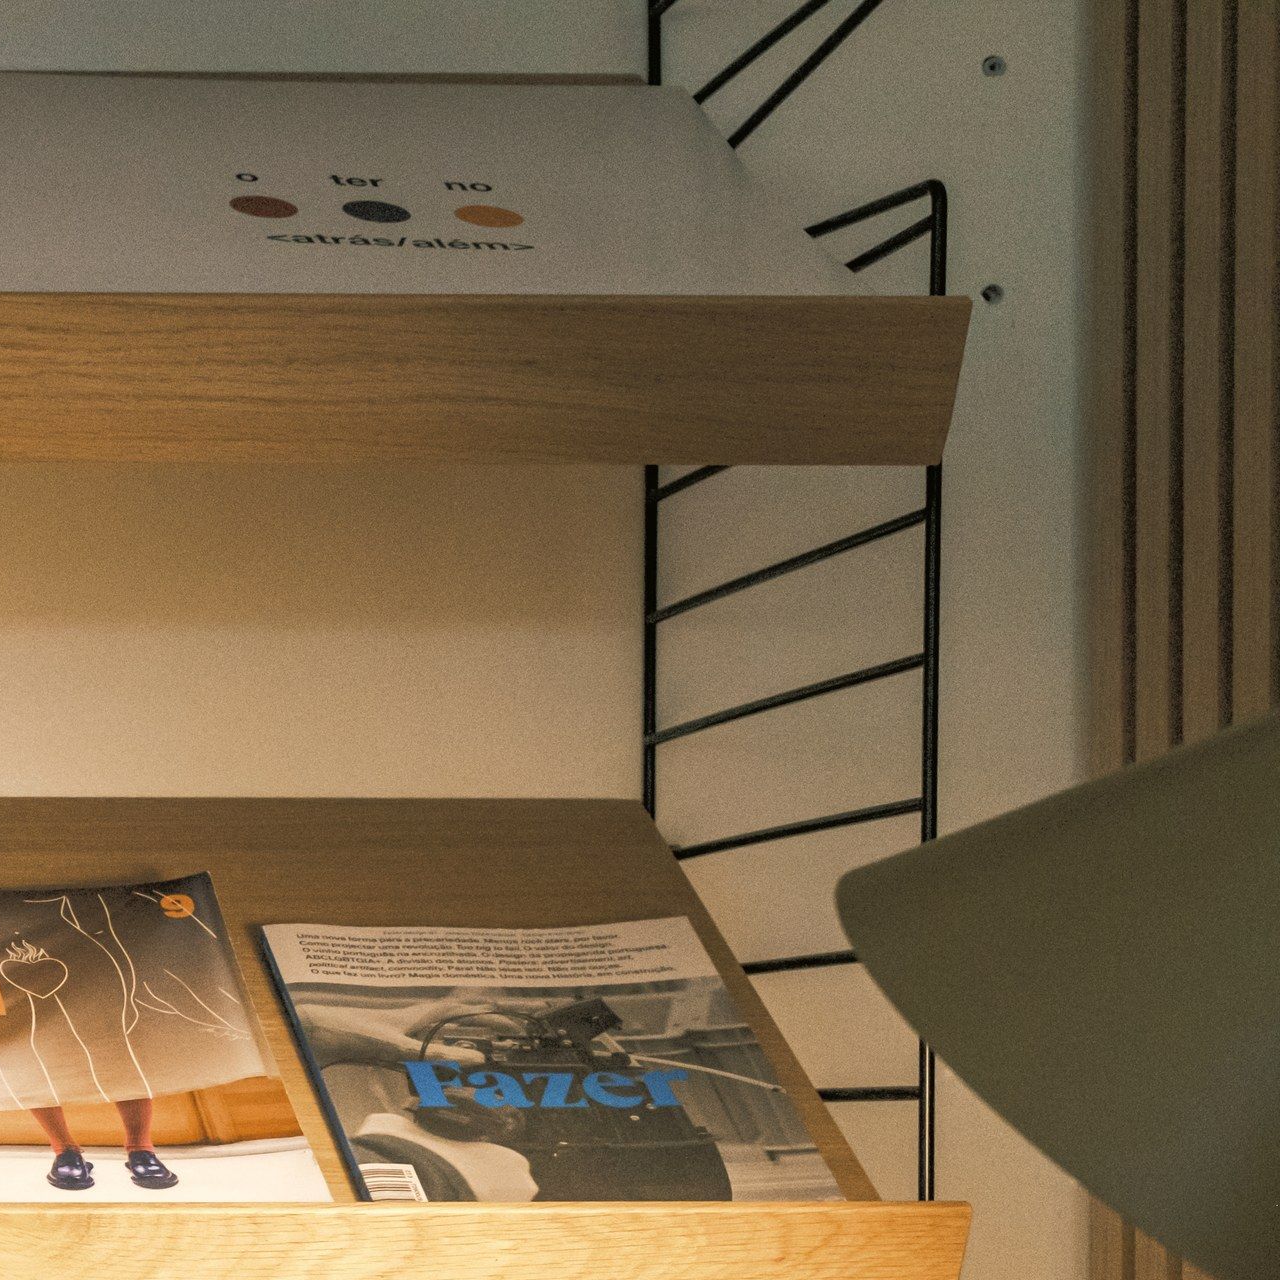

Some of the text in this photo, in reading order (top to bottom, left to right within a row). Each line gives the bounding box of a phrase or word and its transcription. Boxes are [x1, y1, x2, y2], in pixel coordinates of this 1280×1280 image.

[236, 172, 493, 192] o ter no
[159, 893, 195, 919] 9
[403, 1059, 689, 1109] Fazer
